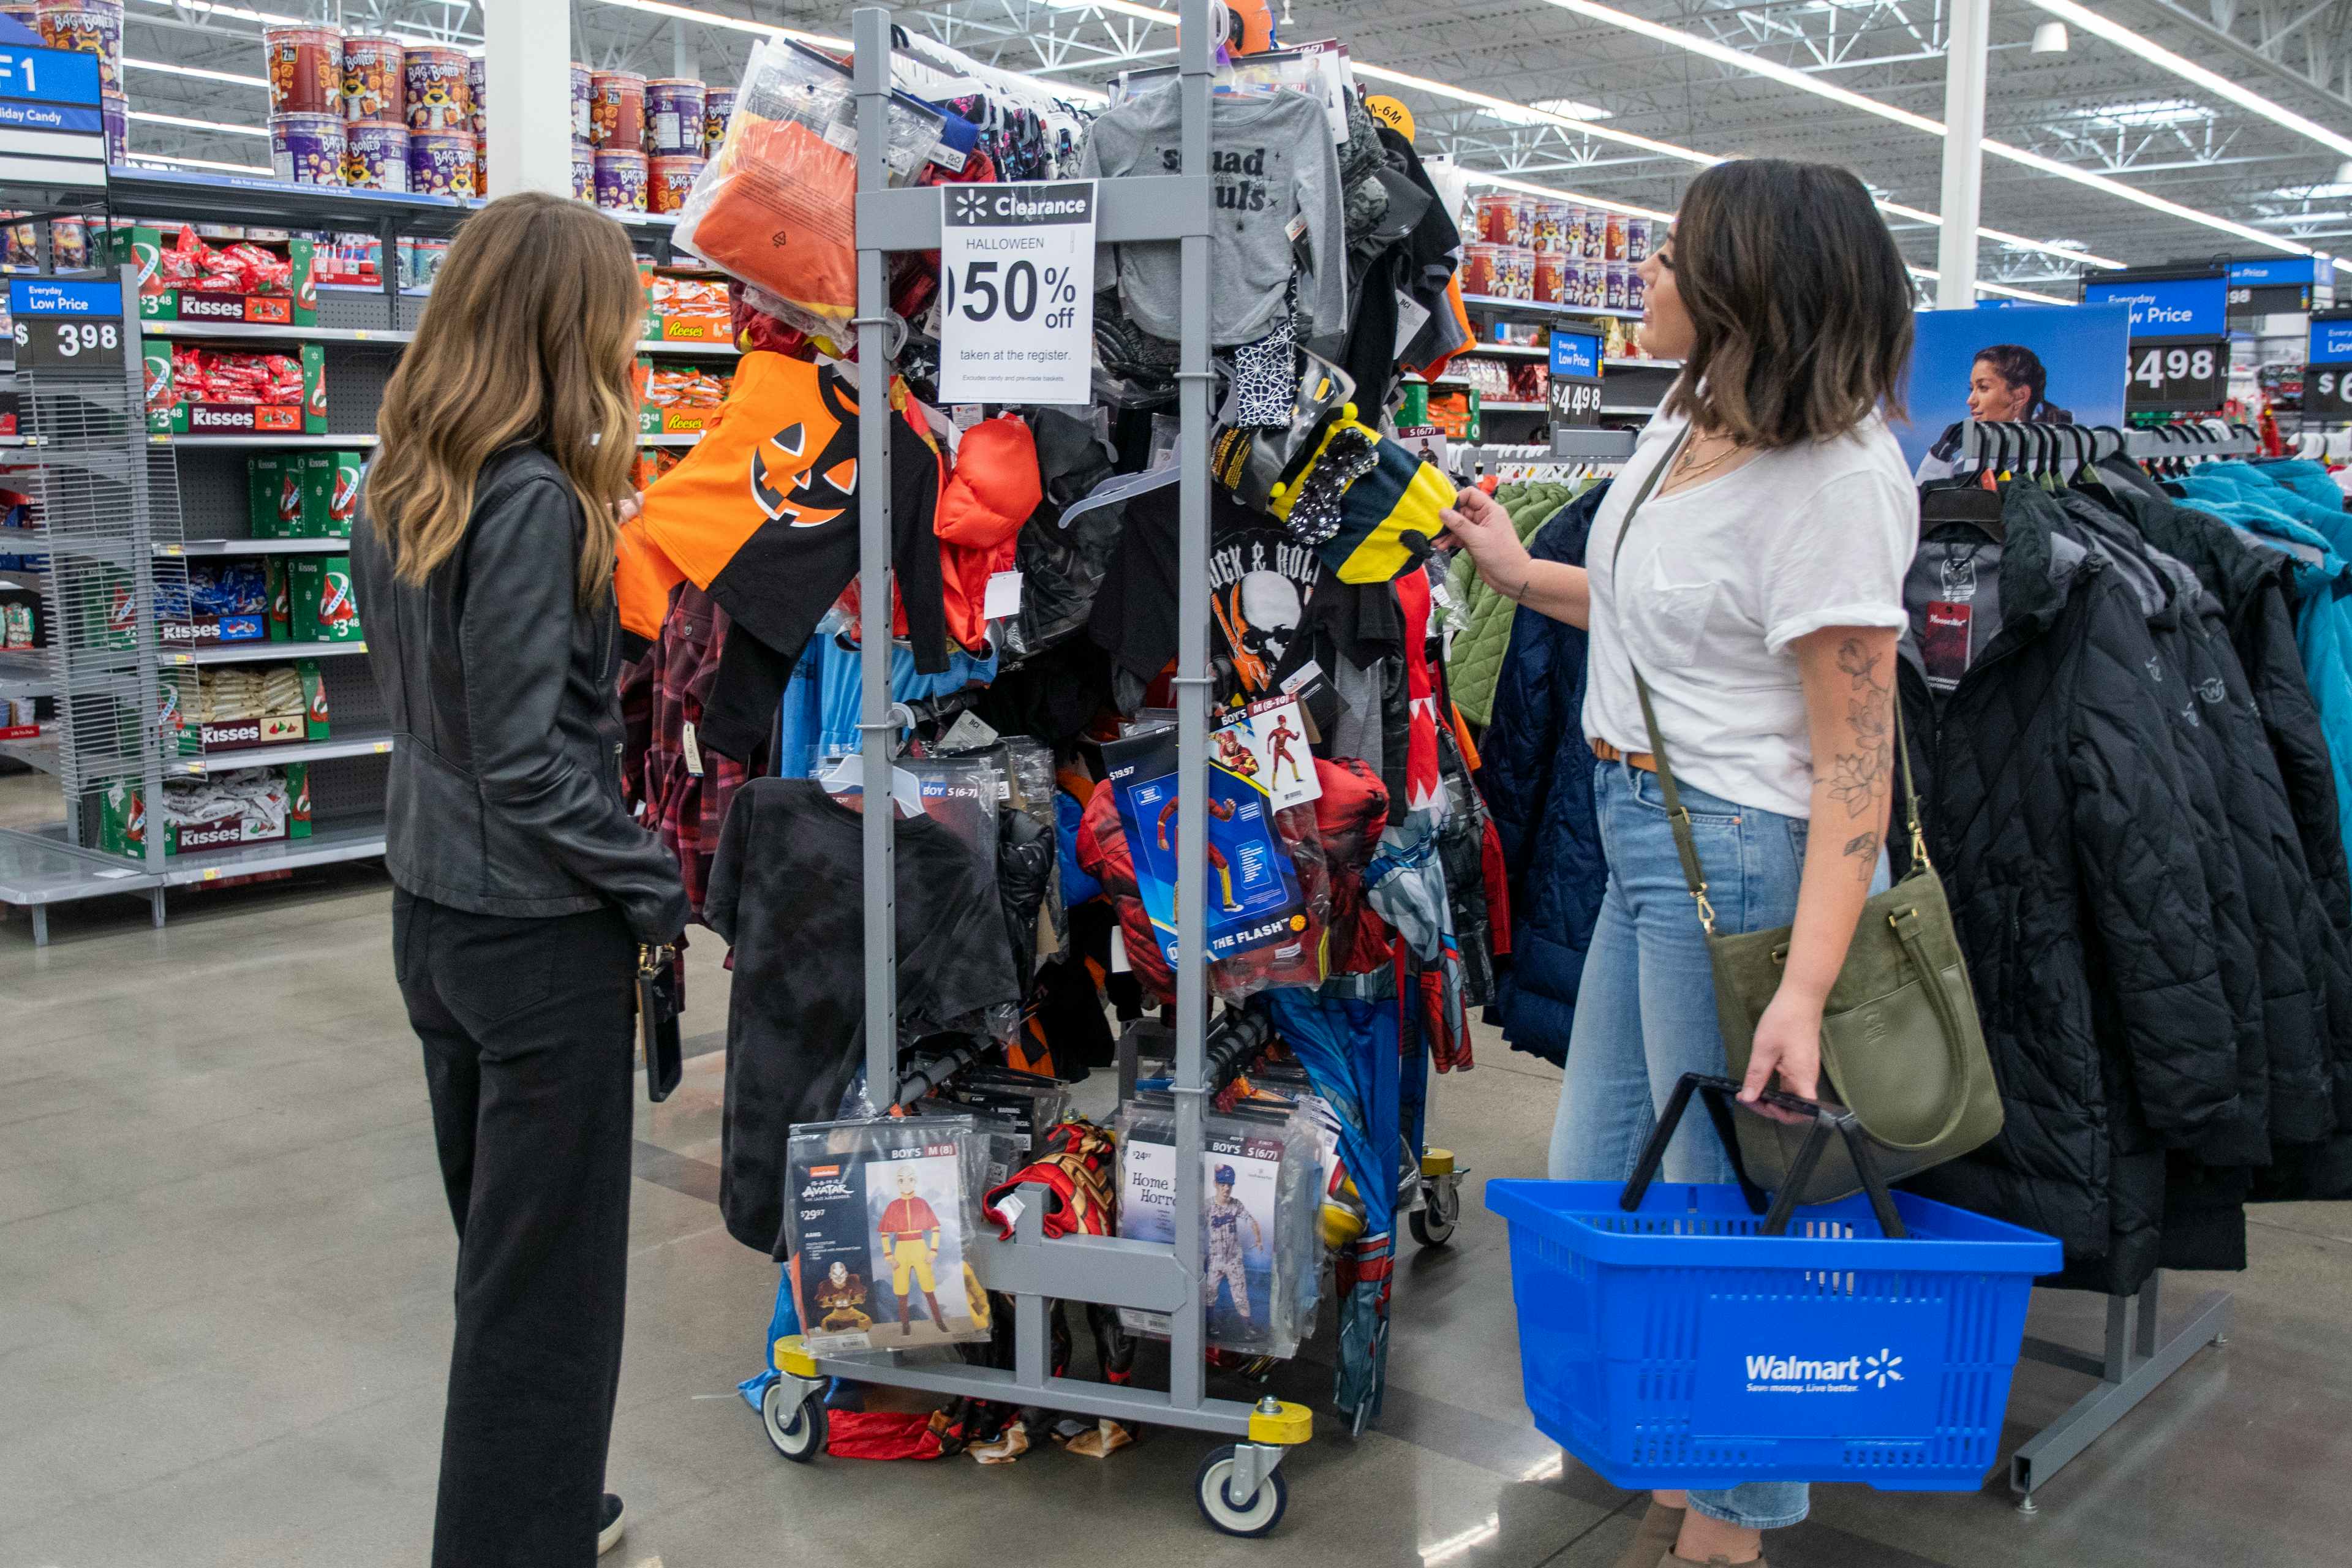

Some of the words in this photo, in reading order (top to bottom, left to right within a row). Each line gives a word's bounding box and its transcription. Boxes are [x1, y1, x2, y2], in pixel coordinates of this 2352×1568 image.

[408, 66, 426, 82] BAG
[26, 110, 61, 126] Candy
[433, 150, 456, 167] BAG
[995, 197, 1087, 217] Clearance
[966, 238, 1044, 250] HALLOWEEN
[29, 286, 62, 295] Everyday
[1044, 266, 1076, 304] %
[31, 298, 55, 309] Low
[58, 297, 89, 311] Price
[2108, 294, 2156, 306] Everyday
[1044, 307, 1076, 329] off
[2147, 307, 2193, 323] Price
[14, 322, 29, 347] $
[1558, 341, 1577, 352] Everyday
[960, 349, 990, 360] taken
[993, 350, 1004, 360] at
[1007, 349, 1024, 360] the
[1027, 350, 1071, 363] register.
[1558, 352, 1572, 365] Low
[1573, 353, 1590, 367] Price
[1210, 544, 1245, 590] OCK
[330, 586, 347, 609] KISSES
[1253, 704, 1262, 714] M
[968, 718, 980, 729] BCI
[1109, 766, 1134, 781] $19.97
[948, 788, 954, 796] S
[1212, 935, 1235, 950] THE
[892, 1148, 921, 1159] BOY'S
[928, 1147, 938, 1156] M
[940, 1145, 953, 1156] (8)
[1213, 1142, 1242, 1155] BOY'S
[1247, 1147, 1254, 1156] S
[1255, 1148, 1279, 1161] (6/7)
[1133, 1172, 1168, 1190] Home
[801, 1184, 855, 1198] AVATAR
[1746, 1355, 1861, 1380] Walmart
[1746, 1383, 1768, 1392] Save
[1770, 1384, 1804, 1393] money.
[1806, 1383, 1826, 1392] Live
[1827, 1383, 1860, 1392] better.
